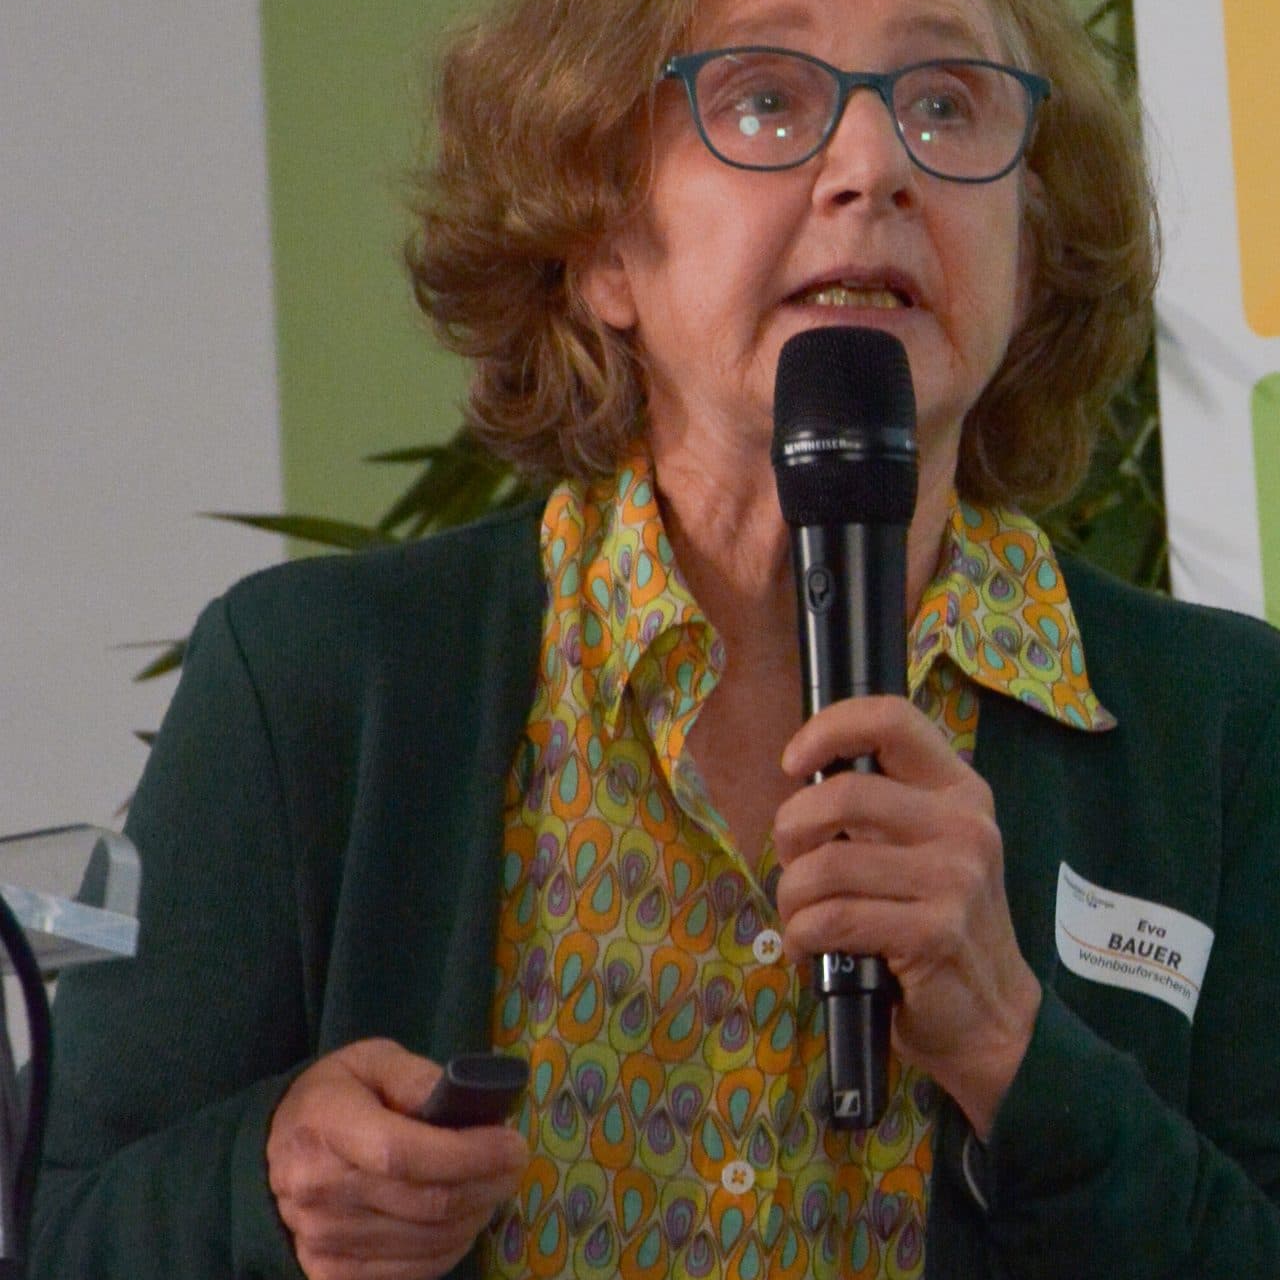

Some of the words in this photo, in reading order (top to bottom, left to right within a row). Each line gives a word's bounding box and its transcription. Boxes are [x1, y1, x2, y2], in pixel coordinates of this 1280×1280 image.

[1137, 918, 1168, 939] Eva
[1108, 933, 1182, 971] BAUER
[1079, 948, 1192, 1000] Wohnbauforscherin
